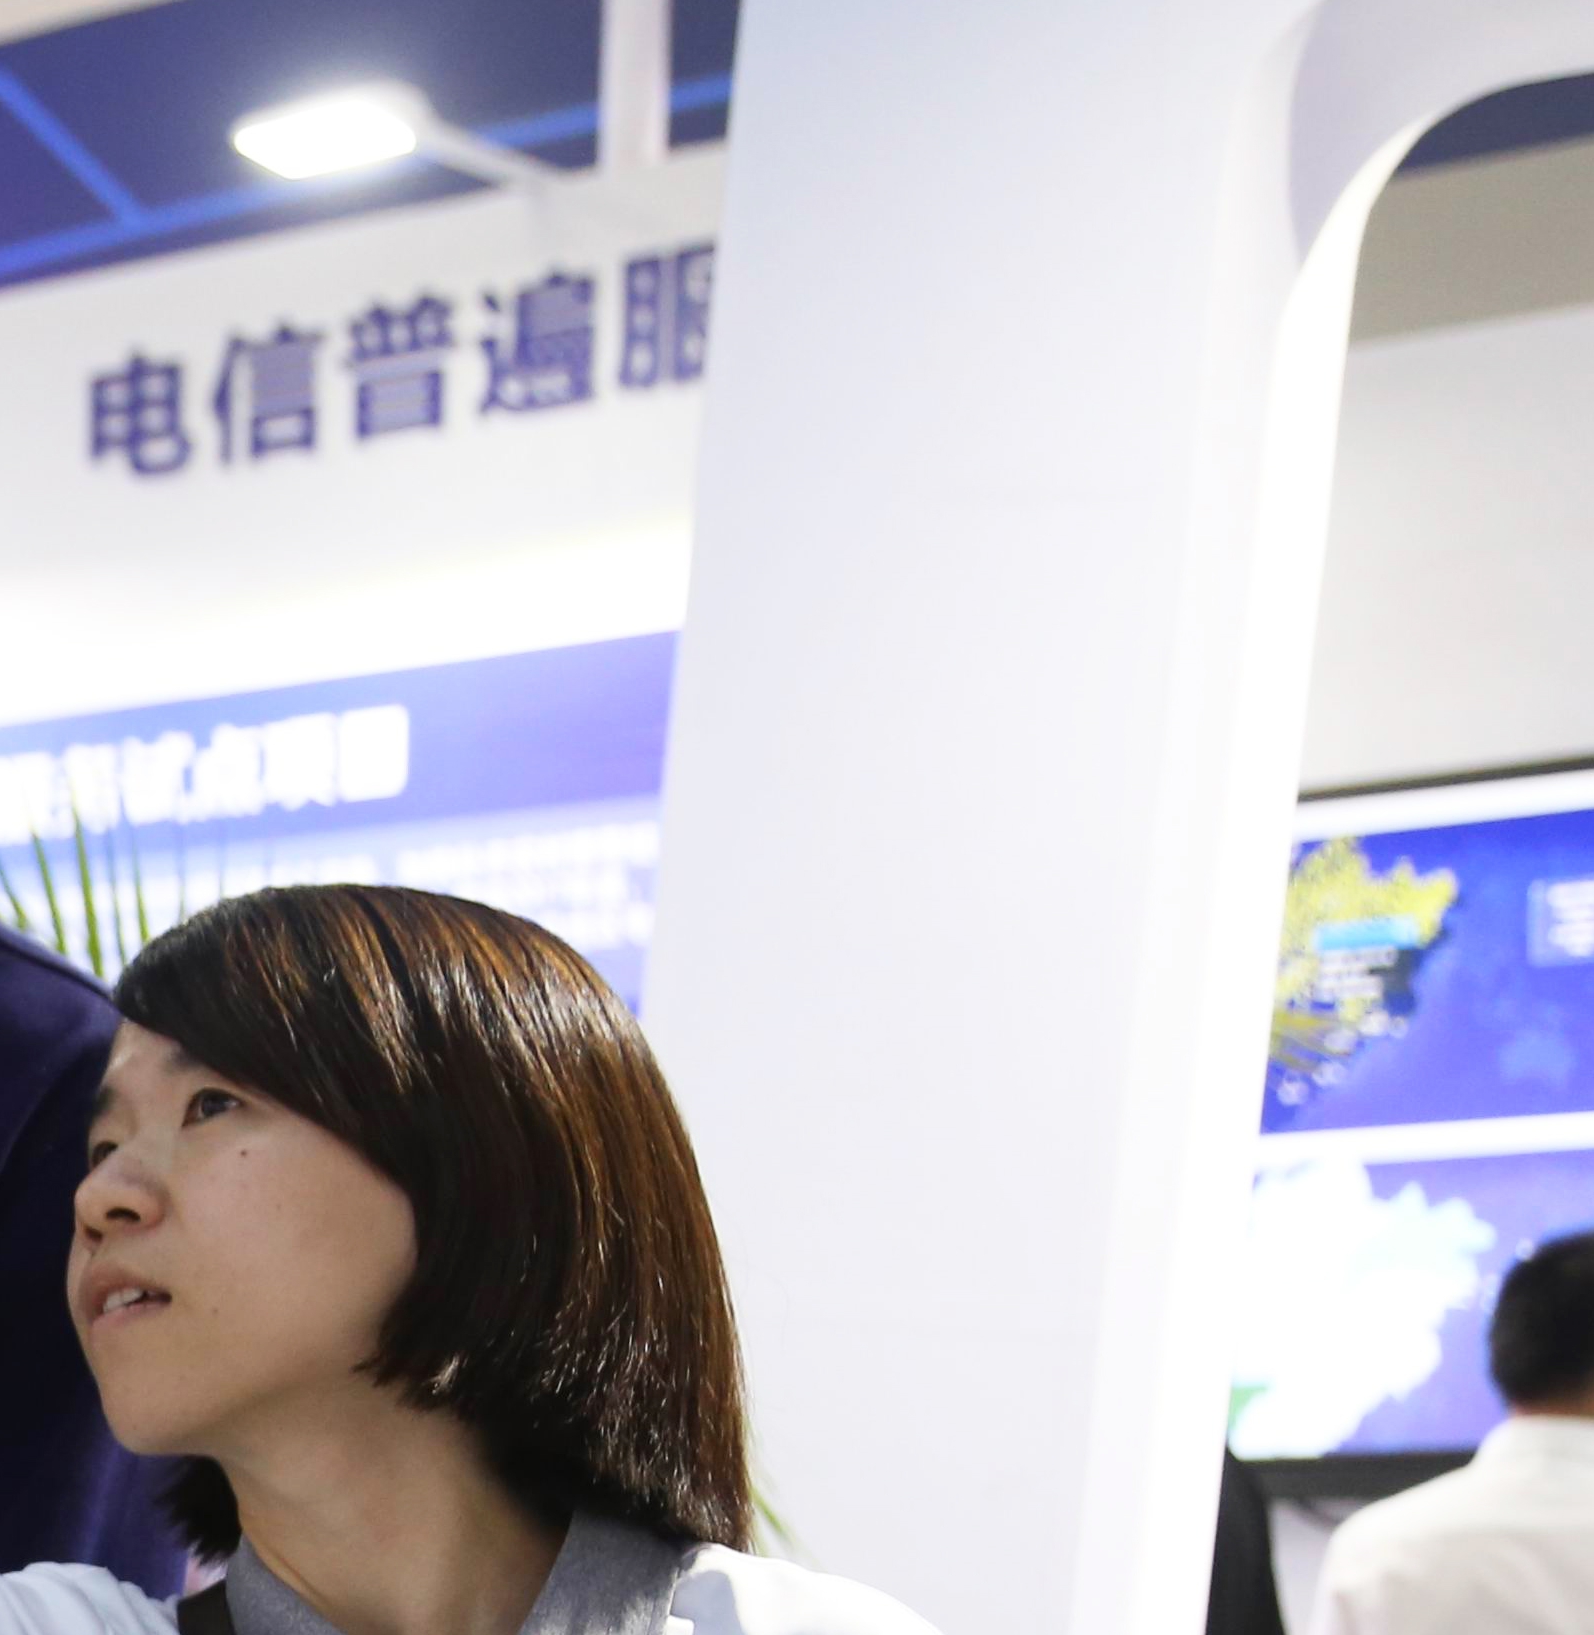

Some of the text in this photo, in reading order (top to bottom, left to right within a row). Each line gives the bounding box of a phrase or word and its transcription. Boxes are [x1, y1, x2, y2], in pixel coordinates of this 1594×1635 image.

[89, 240, 715, 476] 电信普遍服
